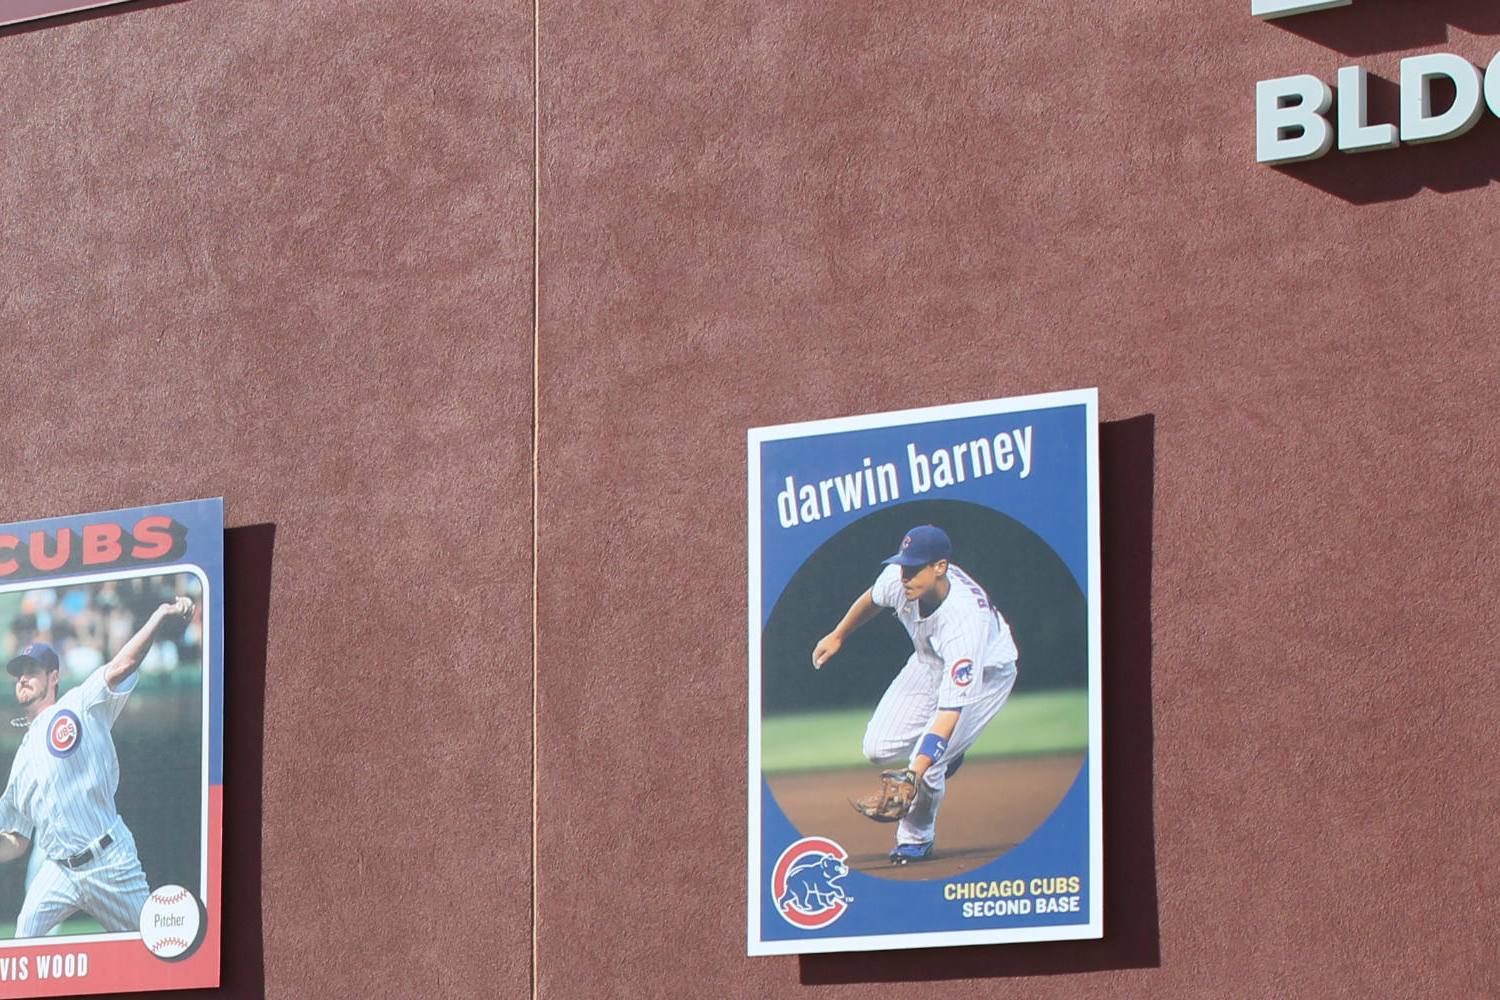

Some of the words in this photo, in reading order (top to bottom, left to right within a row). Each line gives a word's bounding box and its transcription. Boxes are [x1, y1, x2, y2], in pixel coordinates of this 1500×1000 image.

[1256, 50, 1500, 166] BLD
[777, 457, 900, 529] darwin
[907, 425, 1033, 494] barney
[944, 879, 1025, 900] CHICAGO
[1030, 876, 1081, 896] CUBS
[962, 898, 1031, 918] SECOND
[1035, 896, 1081, 914] BASE
[153, 913, 186, 929] Pitcher
[36, 953, 88, 979] WOOD
